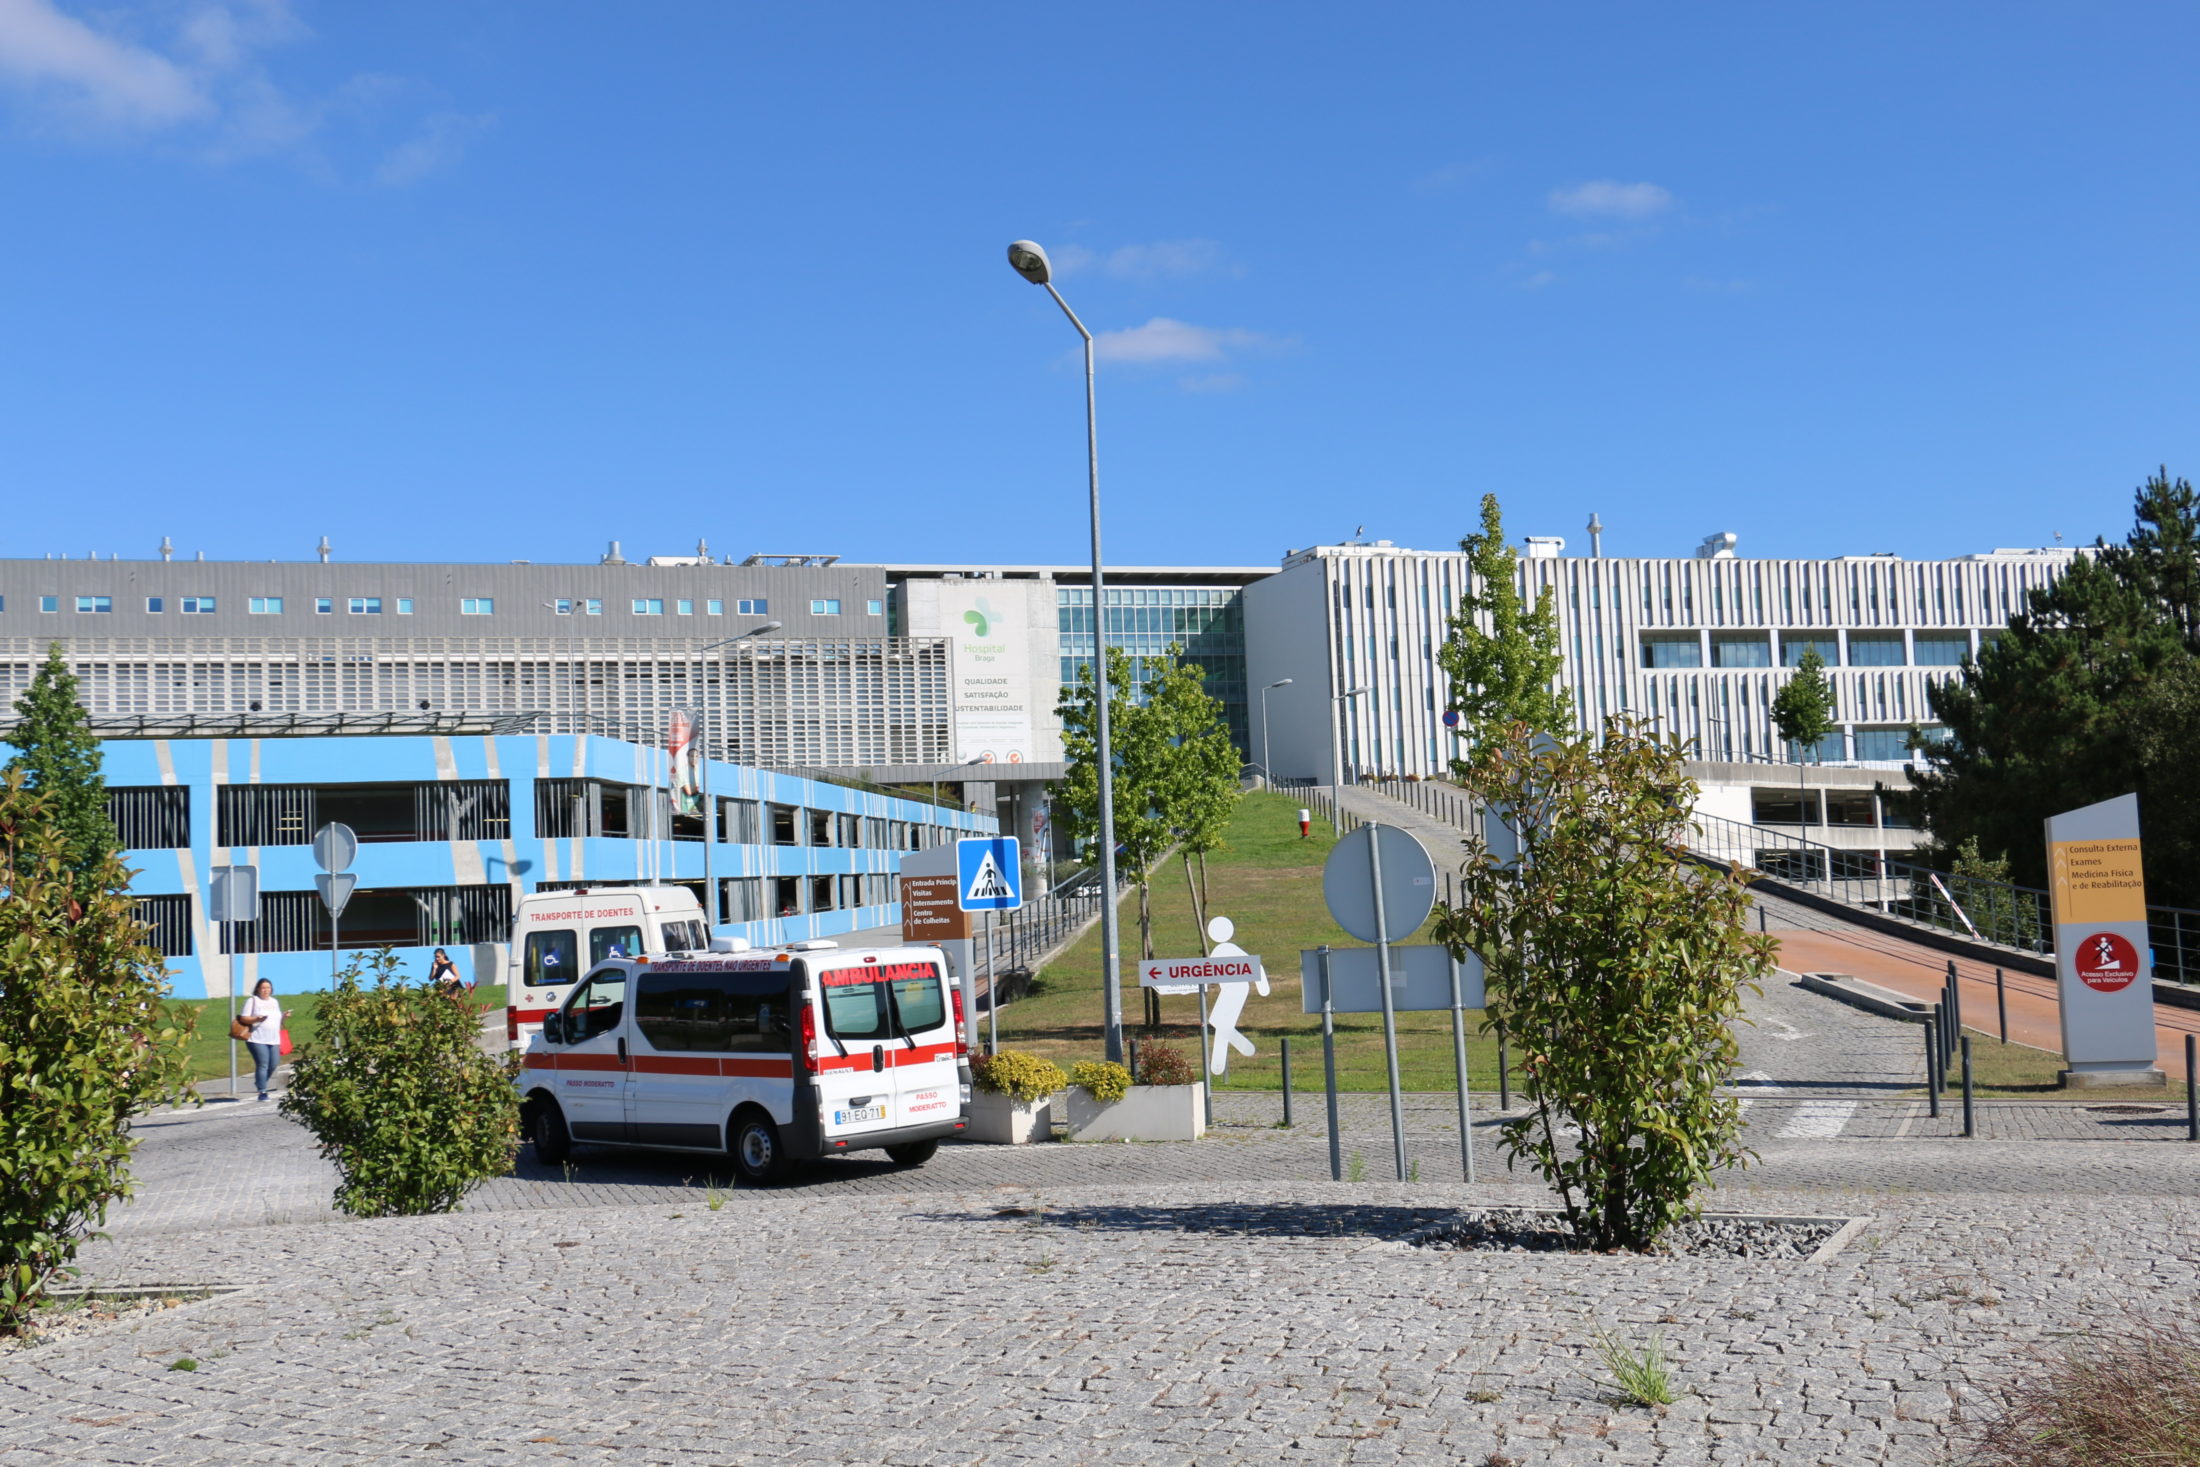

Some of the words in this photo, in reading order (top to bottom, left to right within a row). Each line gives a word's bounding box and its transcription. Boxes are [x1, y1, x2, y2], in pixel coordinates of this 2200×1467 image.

[964, 643, 1006, 655] Hospital
[975, 654, 995, 662] Braga
[964, 678, 1008, 686] QUALIDADE
[964, 691, 1009, 699] SATISFAÇÃO
[2069, 844, 2105, 853] Consulta
[2106, 844, 2138, 852] Externa
[2070, 858, 2102, 866] Exames
[2071, 870, 2109, 879] Medicina
[2091, 879, 2143, 889] Reabilitação
[912, 899, 954, 907] Internamento
[530, 910, 583, 922] TRANSPORTE
[584, 909, 595, 919] DE
[597, 907, 634, 917] DOENTES
[1168, 961, 1252, 979] URGÊNCIA
[916, 1092, 938, 1100] PASSO
[909, 1102, 947, 1113] MODERATTO
